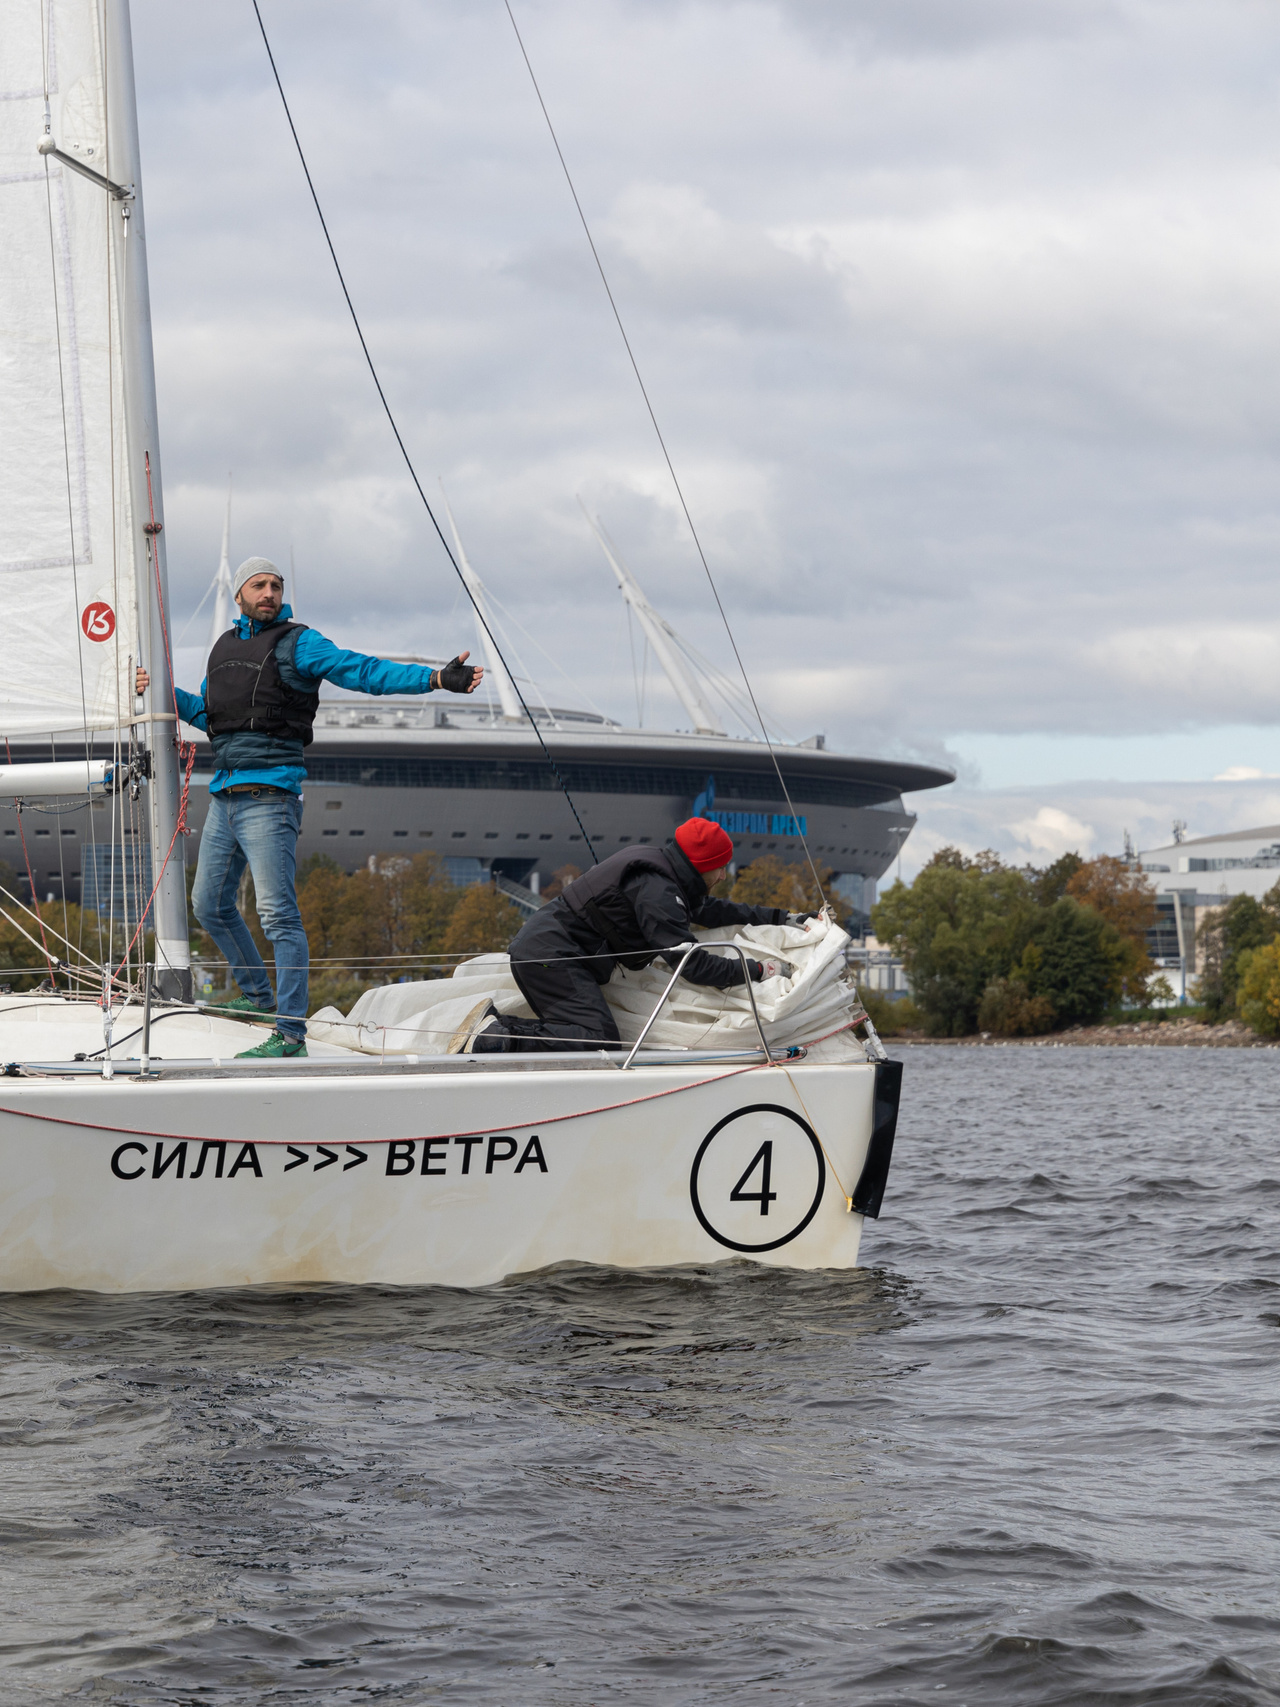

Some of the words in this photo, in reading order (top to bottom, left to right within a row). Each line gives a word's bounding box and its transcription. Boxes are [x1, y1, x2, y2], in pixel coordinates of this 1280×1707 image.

[771, 814, 807, 836] АРЕНА
[110, 1141, 263, 1180] СИЛА
[385, 1135, 548, 1176] ВЕТРА
[730, 1140, 777, 1216] 4
